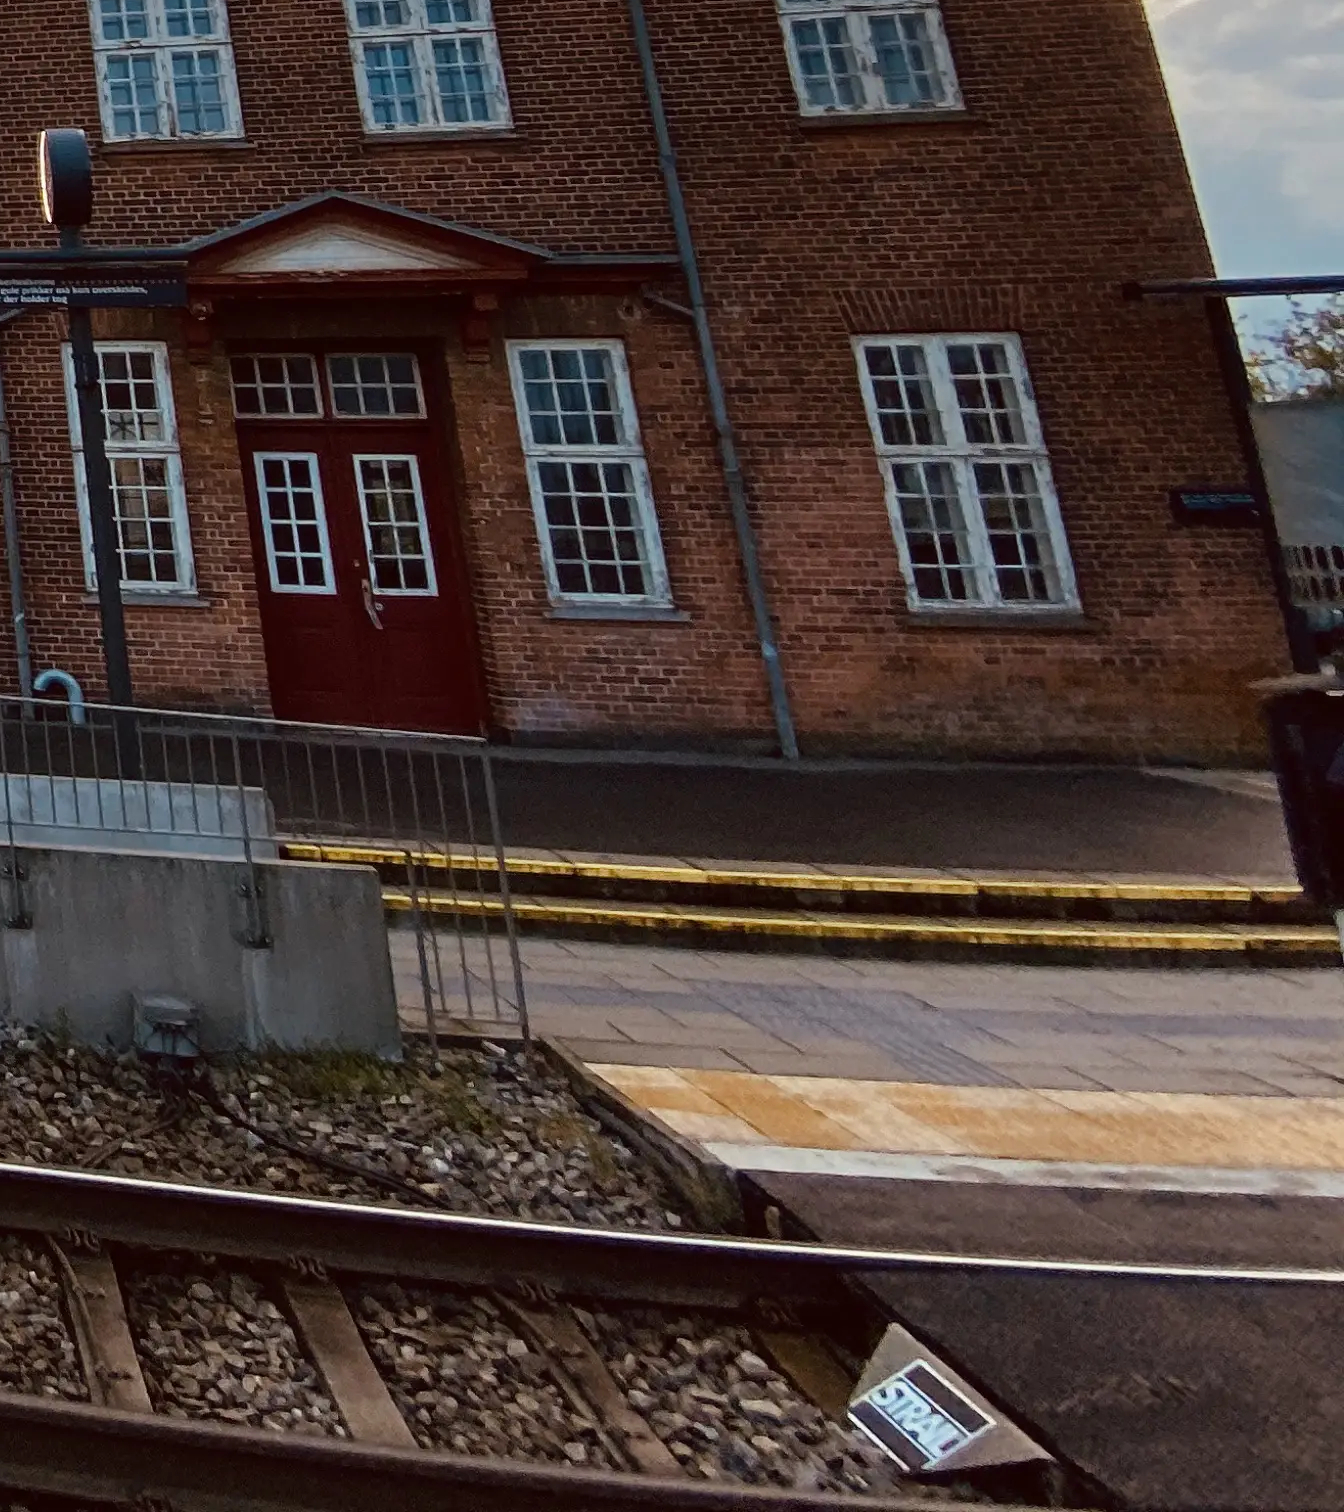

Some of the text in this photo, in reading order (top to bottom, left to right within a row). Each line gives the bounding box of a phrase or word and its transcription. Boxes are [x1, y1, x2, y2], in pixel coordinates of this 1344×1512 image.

[0, 286, 20, 295] gule
[21, 286, 53, 295] prikker
[55, 286, 70, 294] må
[72, 286, 90, 294] kun
[3, 295, 18, 303] der
[20, 295, 50, 303] holder
[51, 295, 68, 304] tog
[869, 1378, 964, 1458] STRAIL
